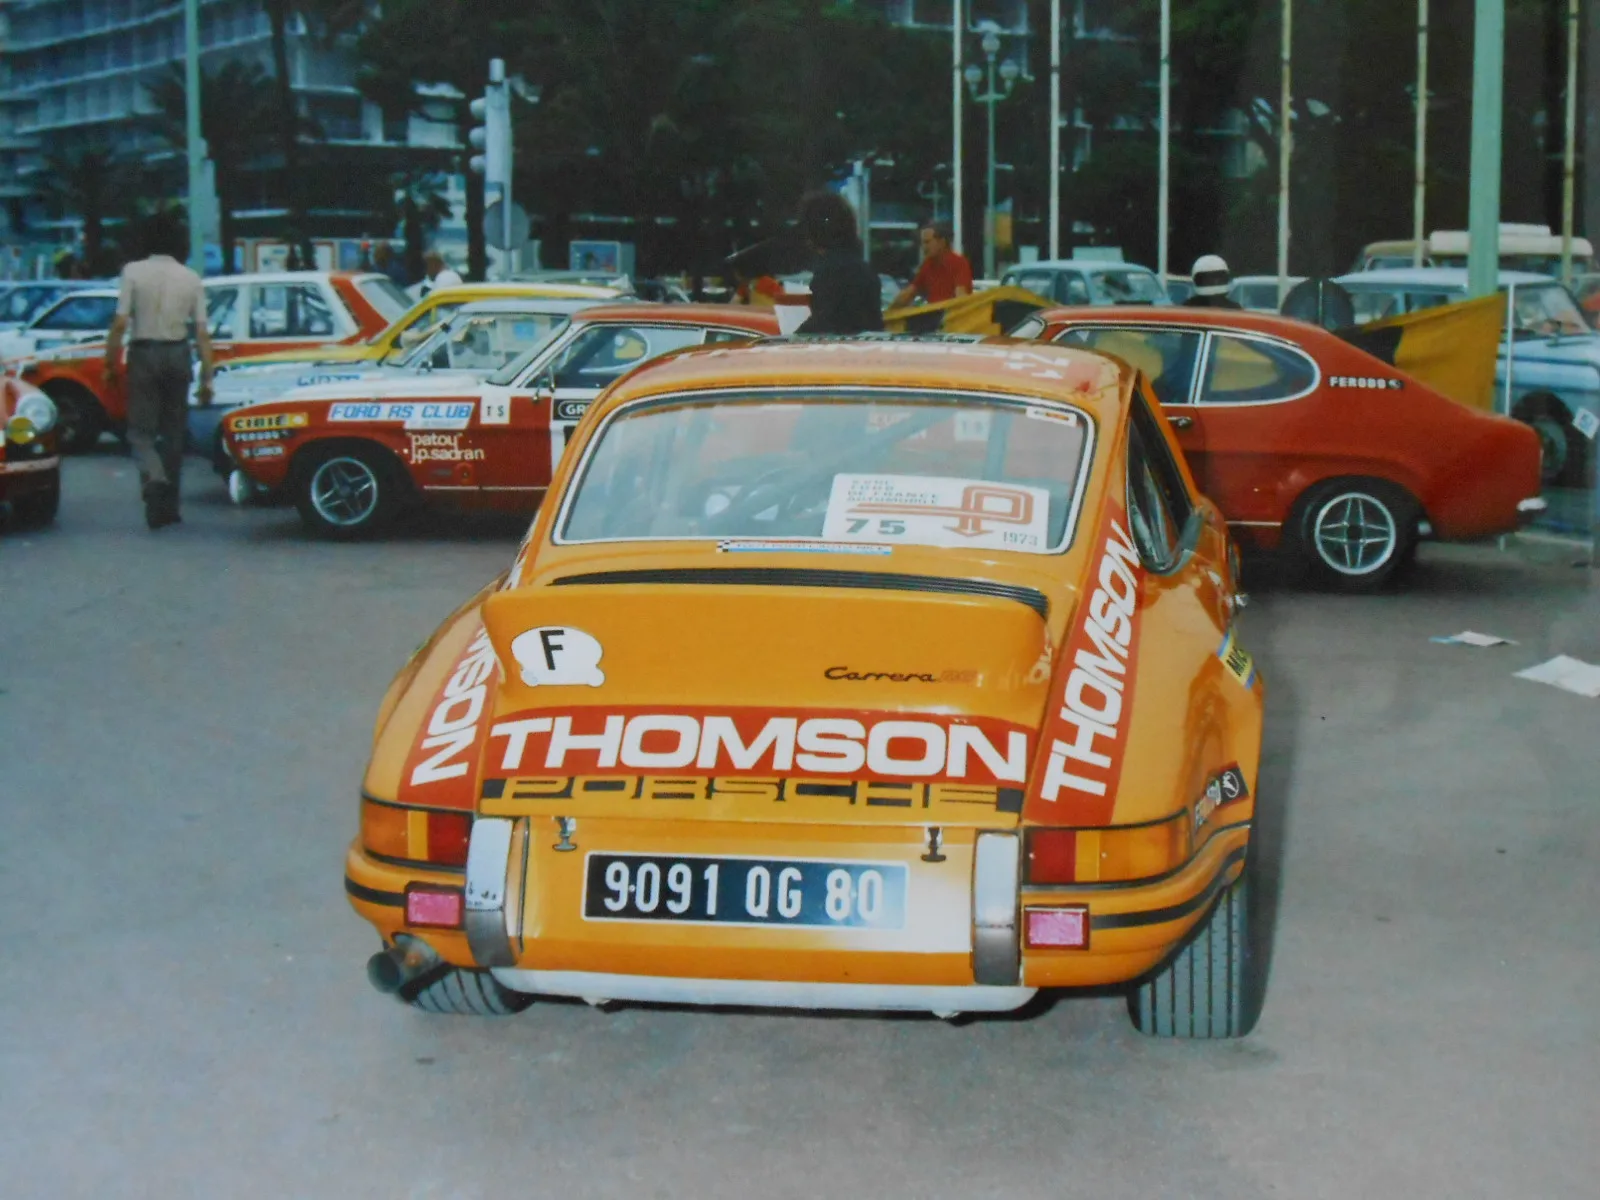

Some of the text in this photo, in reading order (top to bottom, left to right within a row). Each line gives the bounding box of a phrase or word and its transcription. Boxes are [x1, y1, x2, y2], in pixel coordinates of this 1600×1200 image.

[1329, 376, 1386, 389] FERODO
[331, 404, 472, 419] FORD RS CLUB
[845, 518, 906, 536] 75
[1002, 530, 1038, 546] 1973
[539, 629, 565, 671] F
[1040, 519, 1140, 802] THOMSON
[824, 666, 937, 682] Carrera
[490, 714, 1027, 784] THOMSON
[501, 776, 998, 812] PORSCHE
[604, 861, 884, 920] 9091 QG 80
